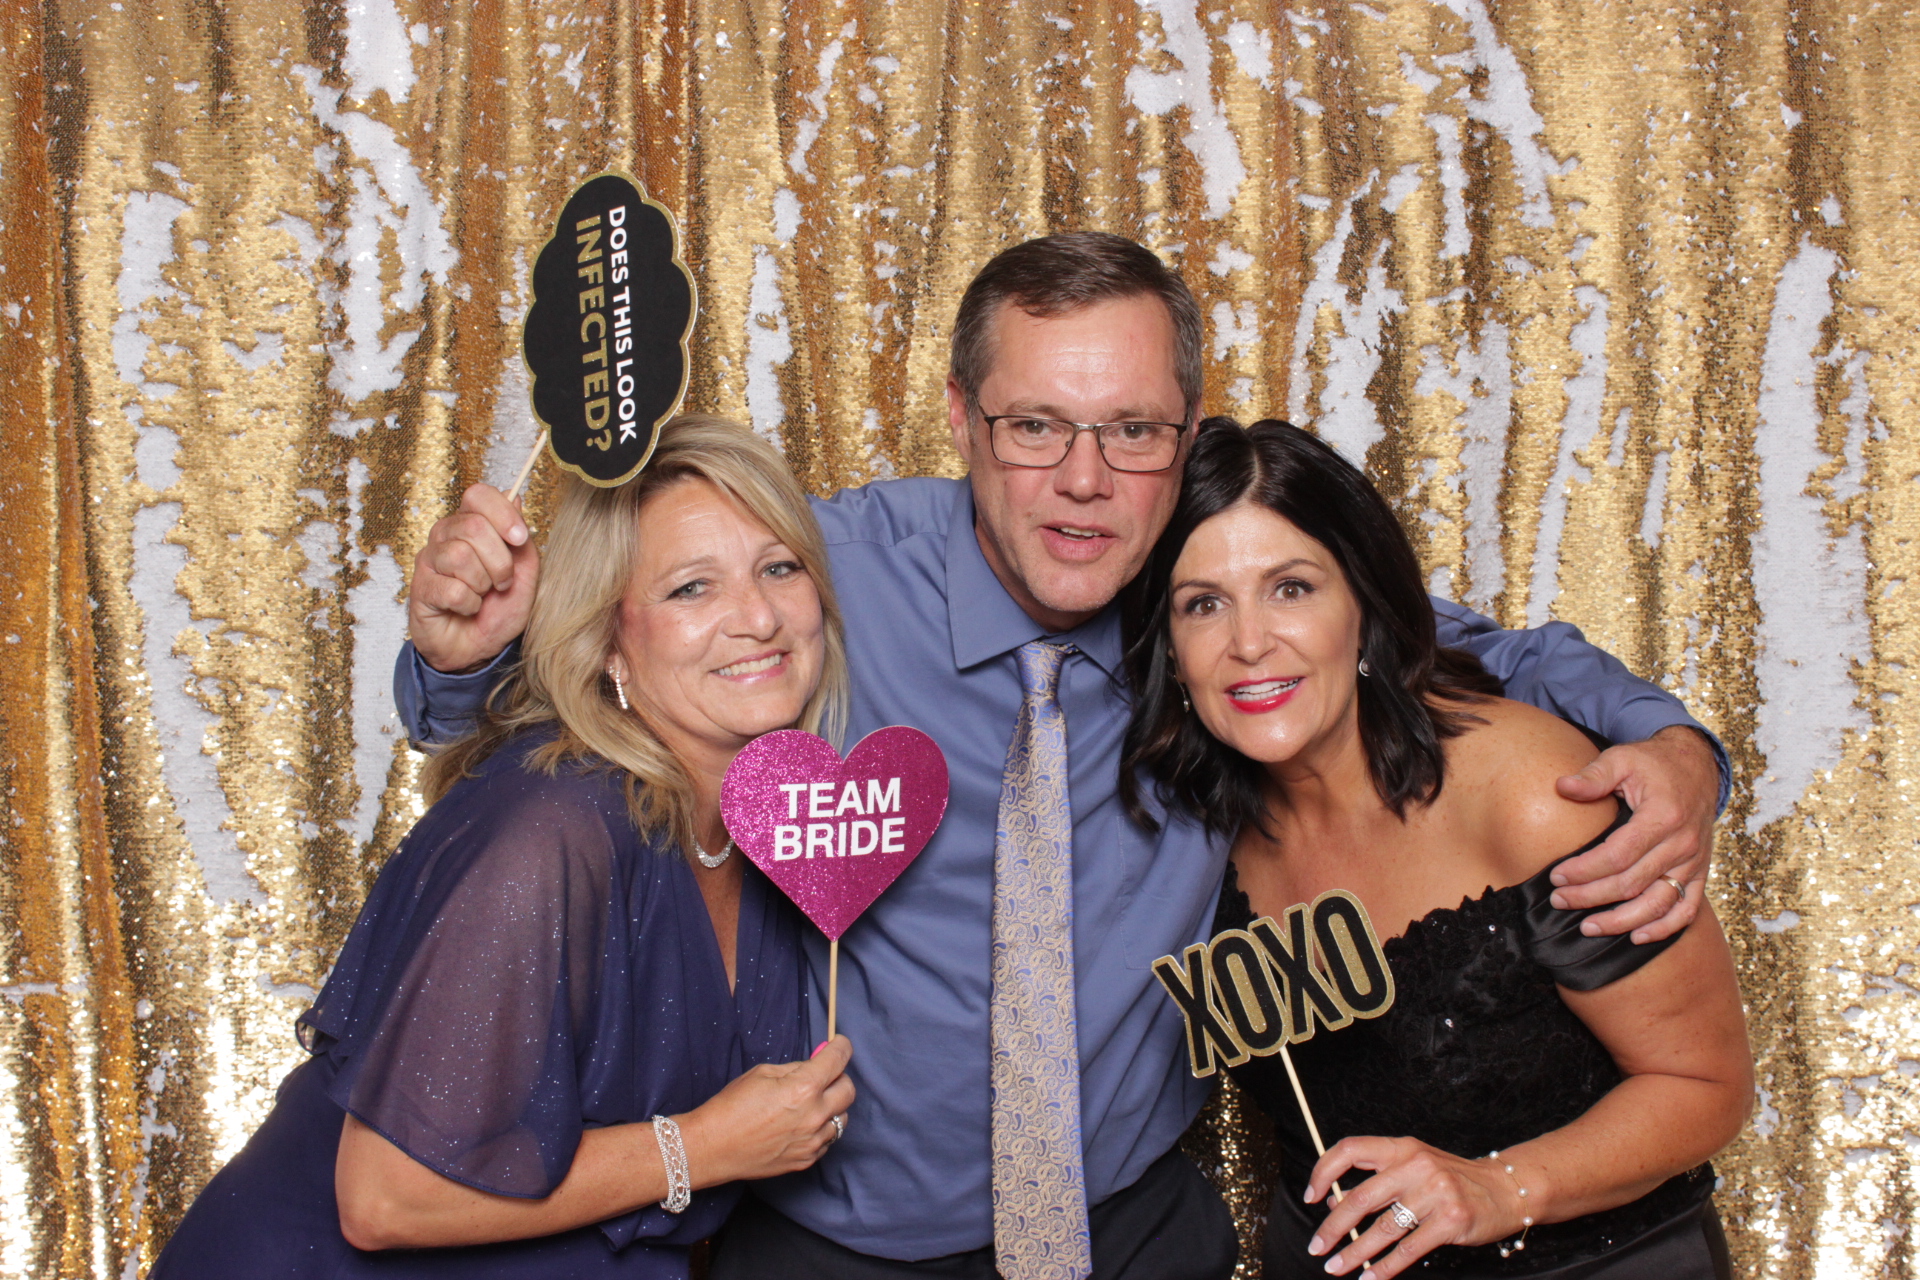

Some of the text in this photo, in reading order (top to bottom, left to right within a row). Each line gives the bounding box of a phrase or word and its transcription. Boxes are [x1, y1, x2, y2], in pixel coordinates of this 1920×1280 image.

[576, 214, 612, 452] INFECTED?
[609, 205, 637, 444] DOES THIS LOOK
[774, 817, 905, 861] BRIDE
[779, 777, 901, 819] TEAM
[1154, 896, 1388, 1071] XOXO
